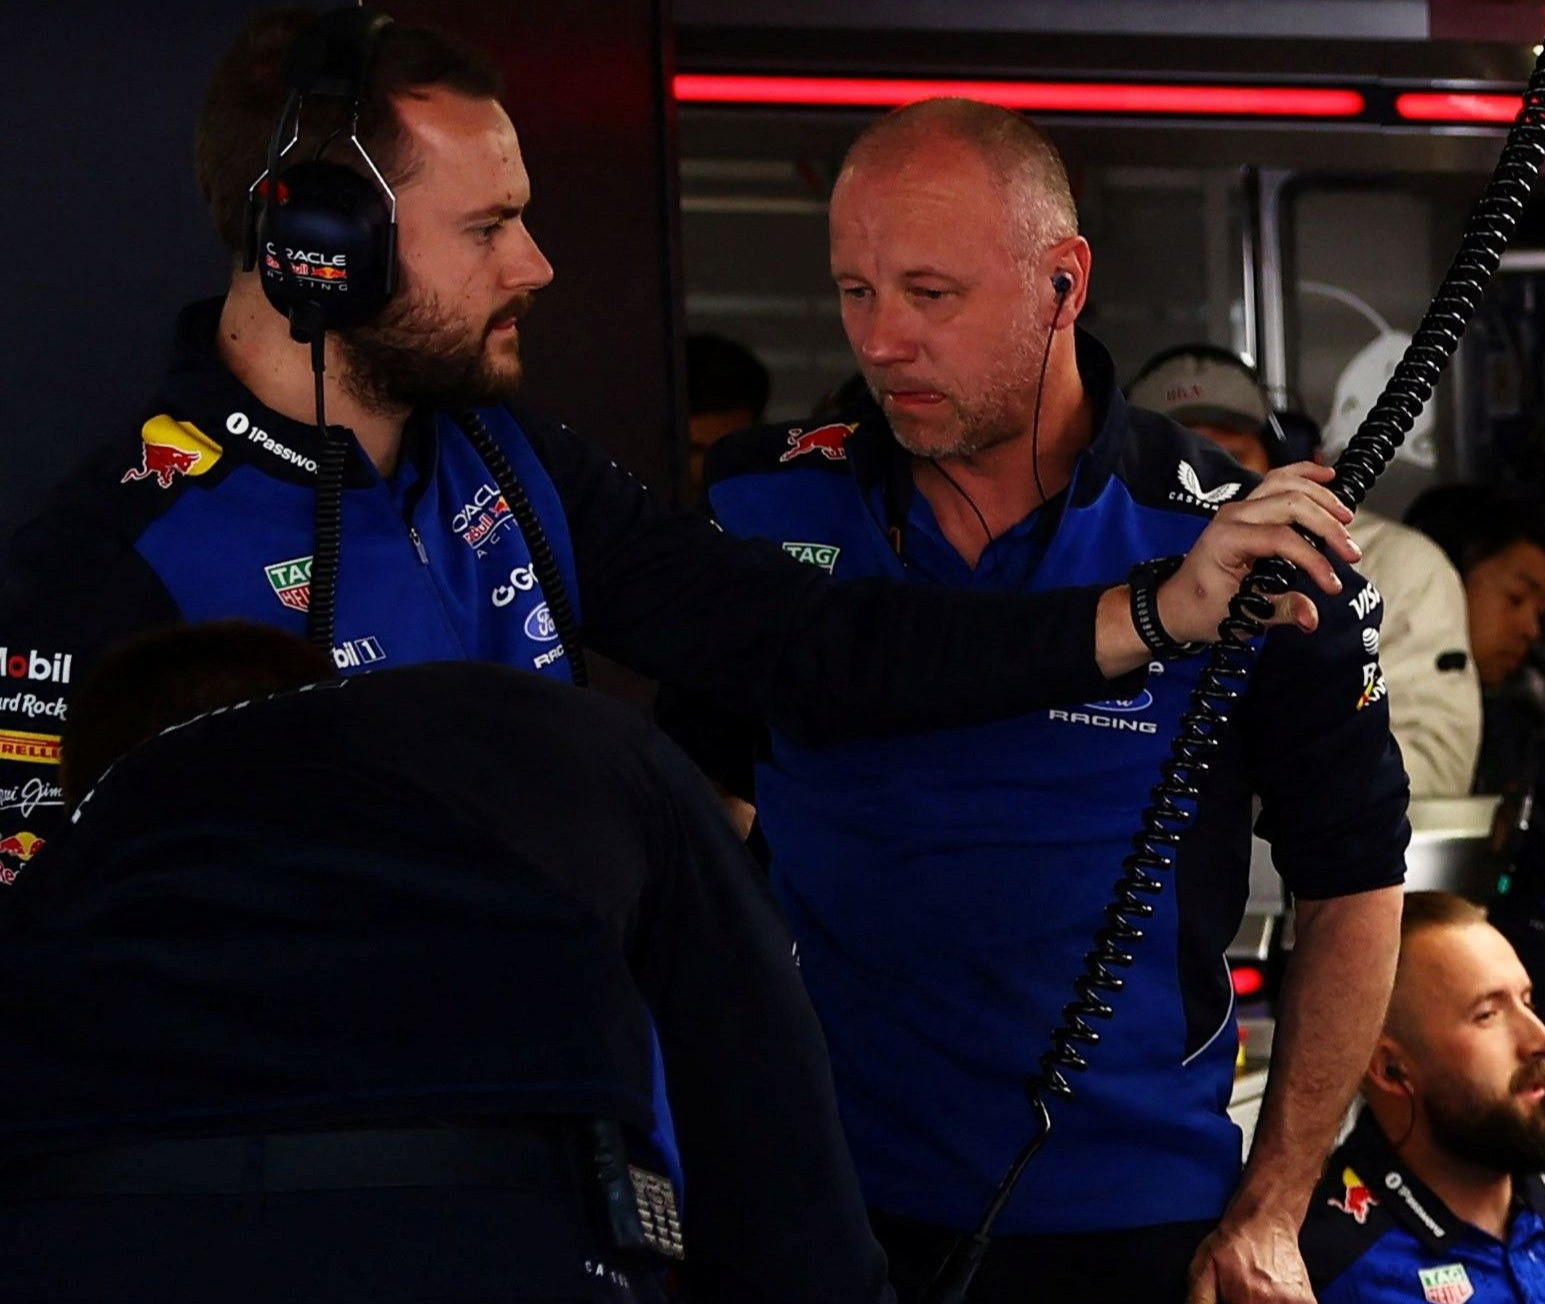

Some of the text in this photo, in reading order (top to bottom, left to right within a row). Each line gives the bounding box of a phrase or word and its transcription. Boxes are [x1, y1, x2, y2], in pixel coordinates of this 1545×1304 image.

[248, 426, 319, 475] 1Passwo
[787, 547, 832, 564] TAG
[0, 648, 72, 684] obil
[21, 692, 68, 721] Rock
[1049, 709, 1158, 734] RACING
